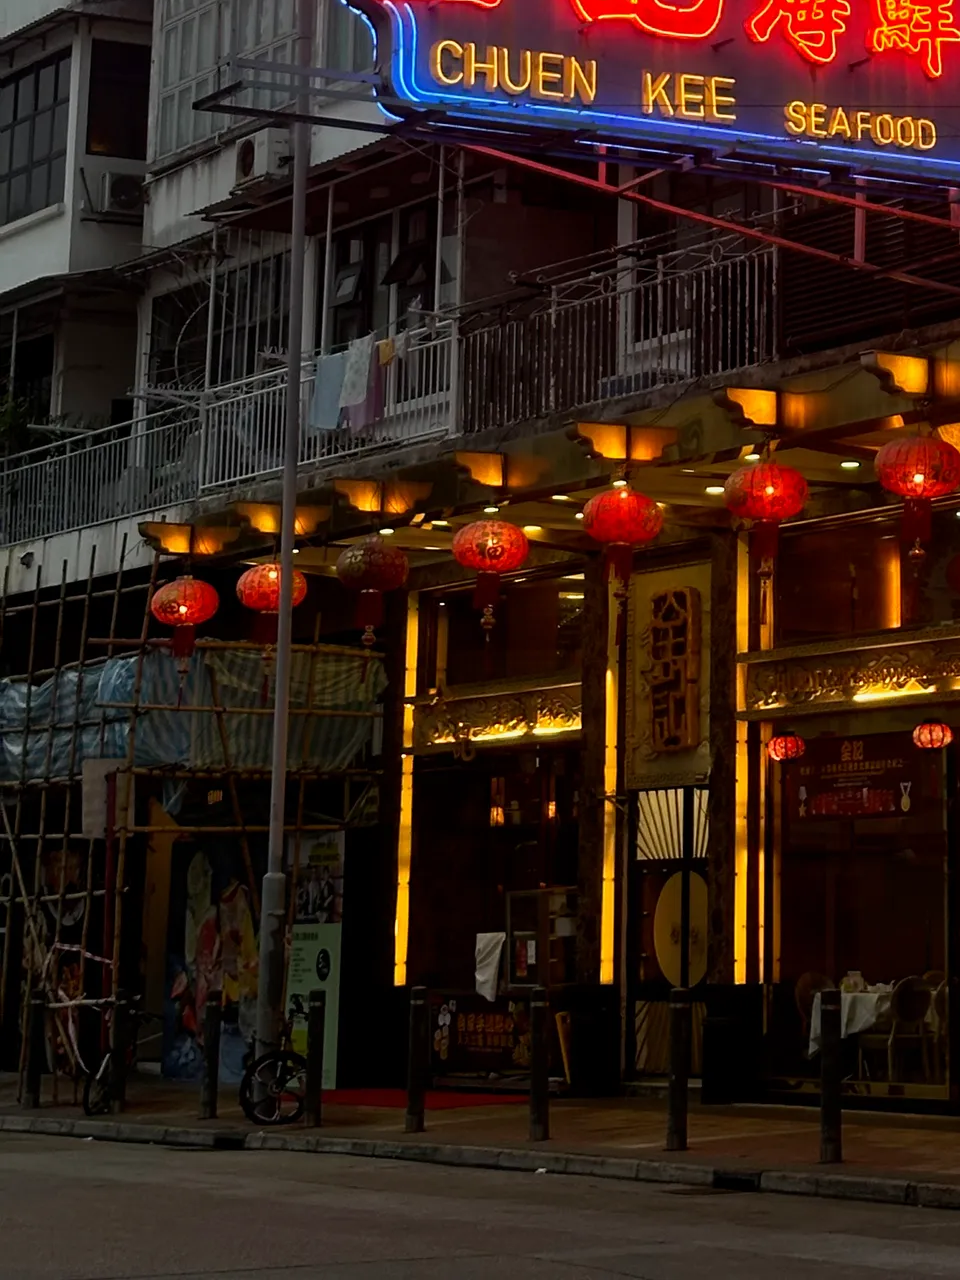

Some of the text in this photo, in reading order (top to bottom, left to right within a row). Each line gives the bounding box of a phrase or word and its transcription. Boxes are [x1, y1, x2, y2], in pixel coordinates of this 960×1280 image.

[433, 40, 598, 103] CHUEN
[643, 71, 738, 122] KEE
[785, 101, 938, 150] SEAFOOD
